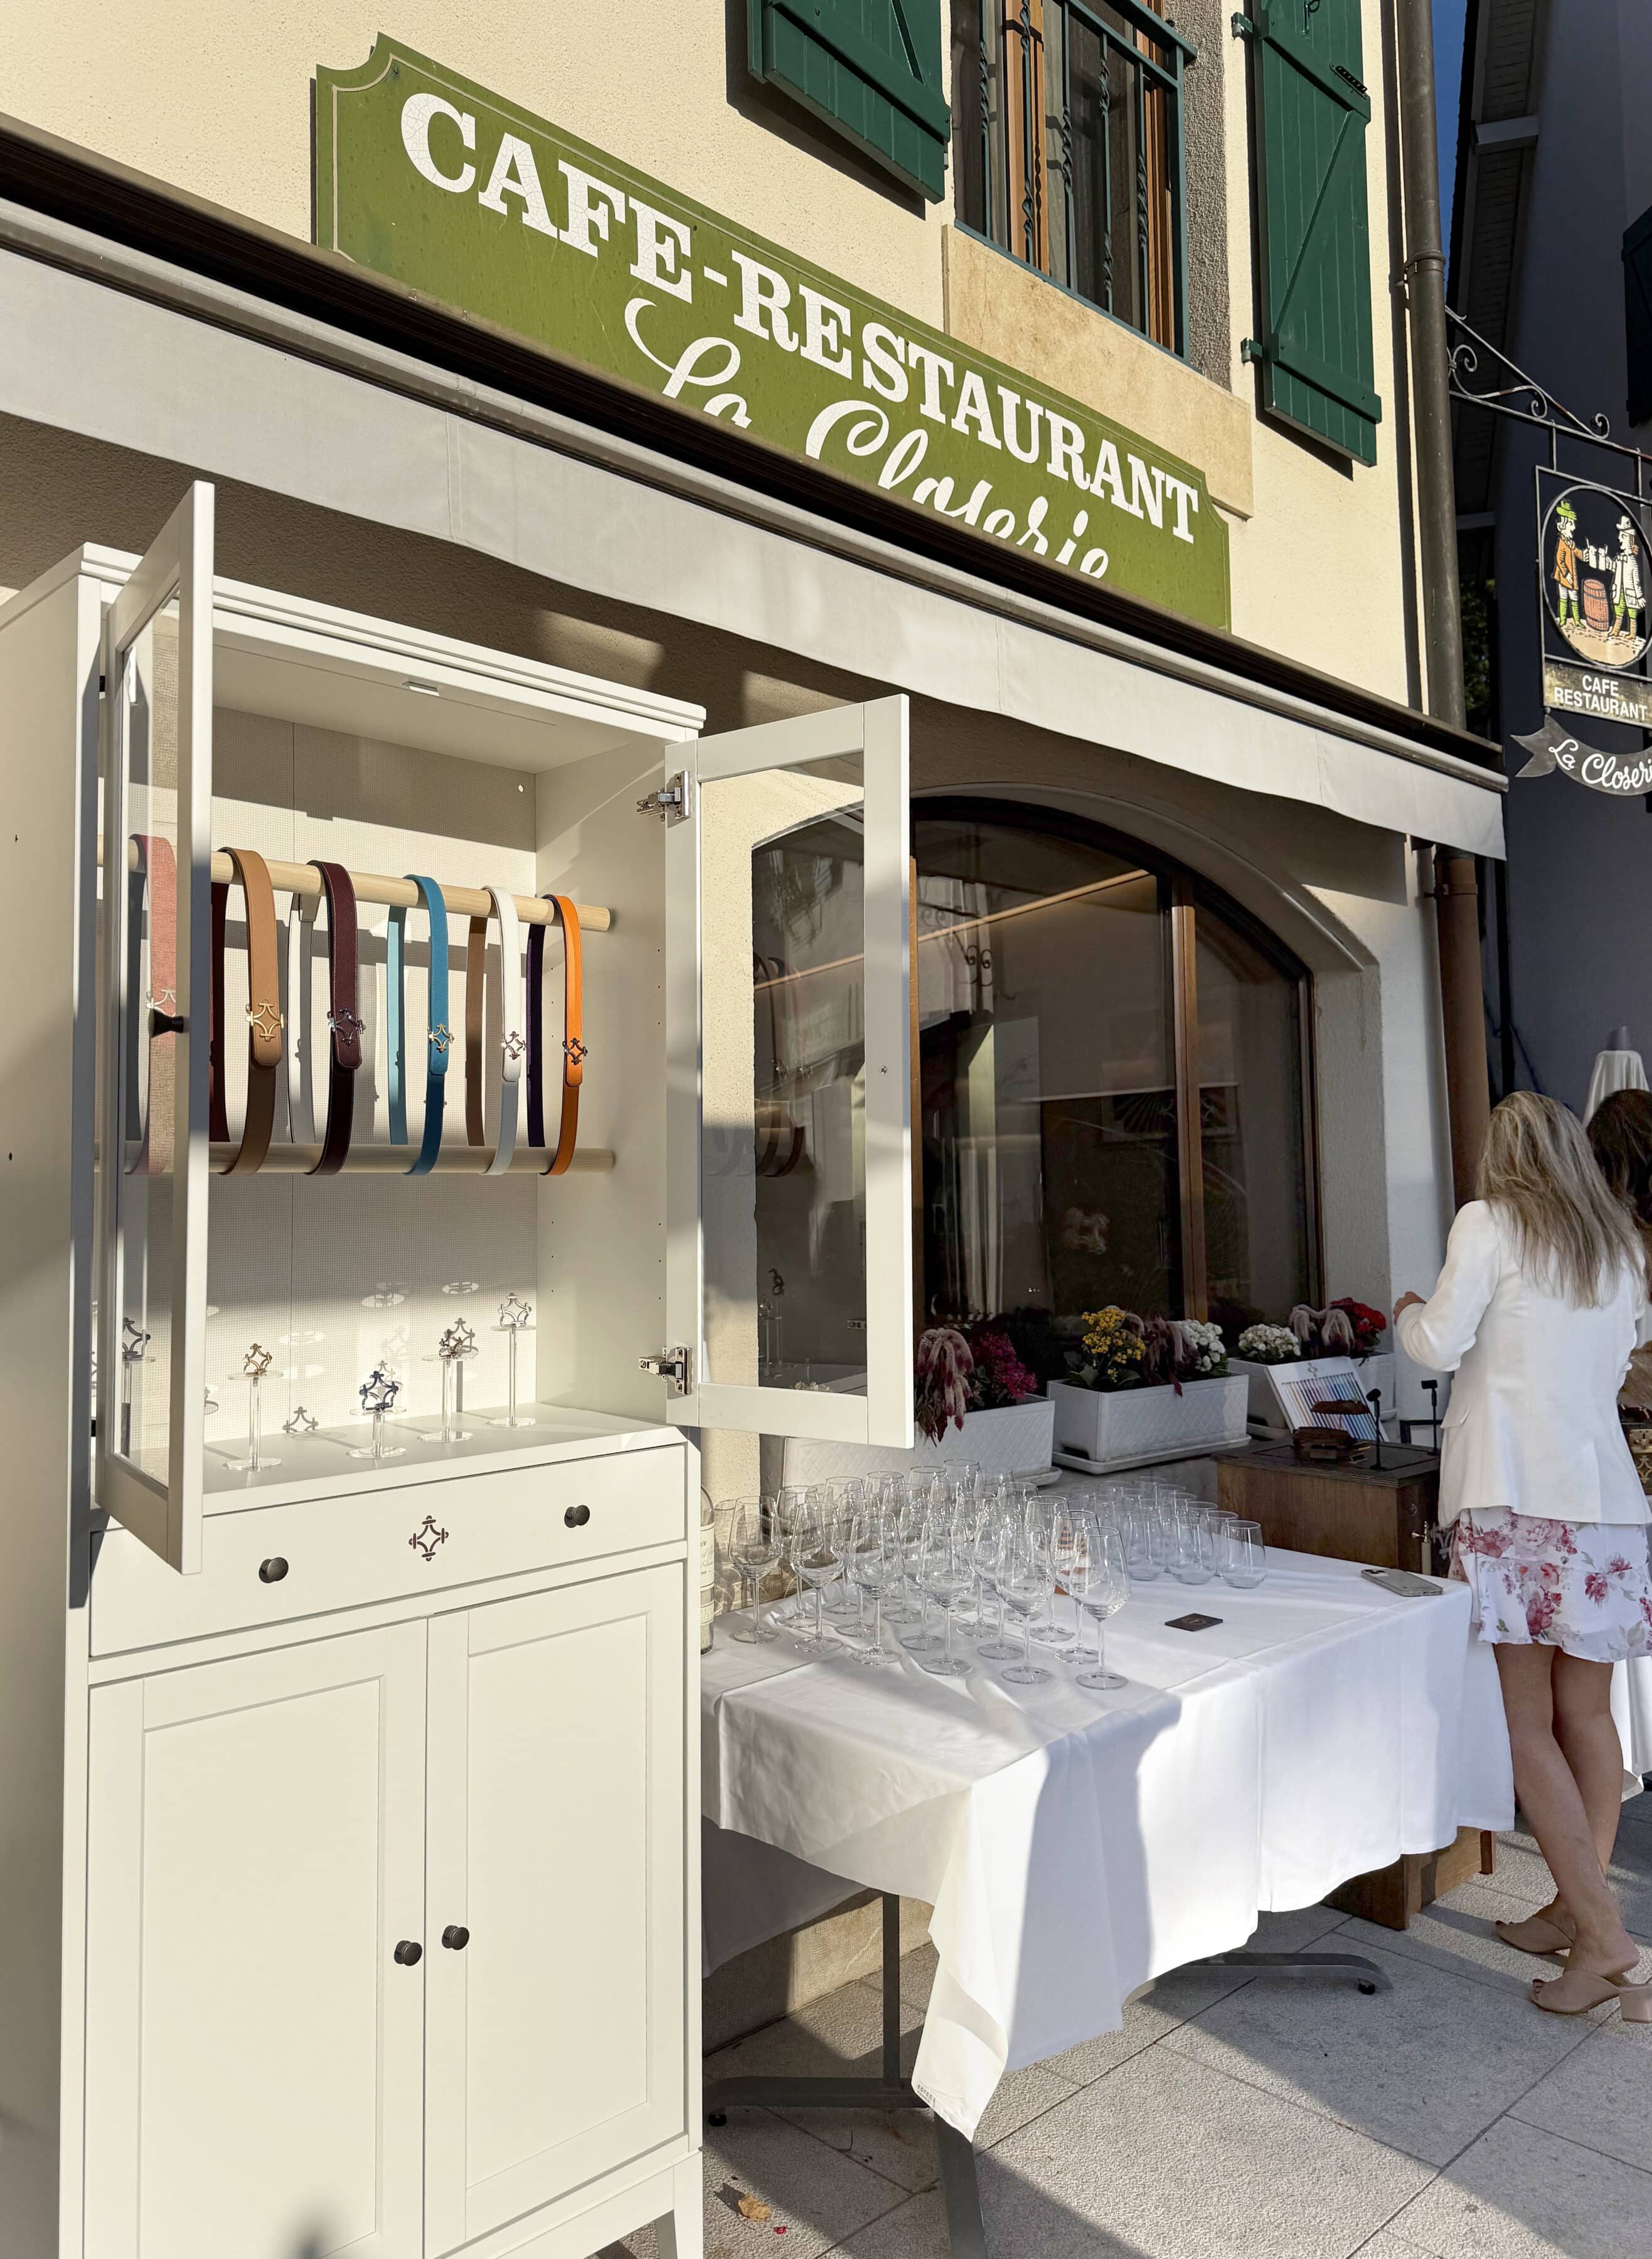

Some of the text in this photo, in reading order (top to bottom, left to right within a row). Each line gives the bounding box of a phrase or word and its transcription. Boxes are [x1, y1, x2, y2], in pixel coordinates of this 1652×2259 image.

[400, 92, 1199, 544] CAFE-RESTAURANT
[1582, 675, 1619, 697] CAFE
[1554, 687, 1648, 720] RESTAURANT
[1548, 739, 1579, 771] La
